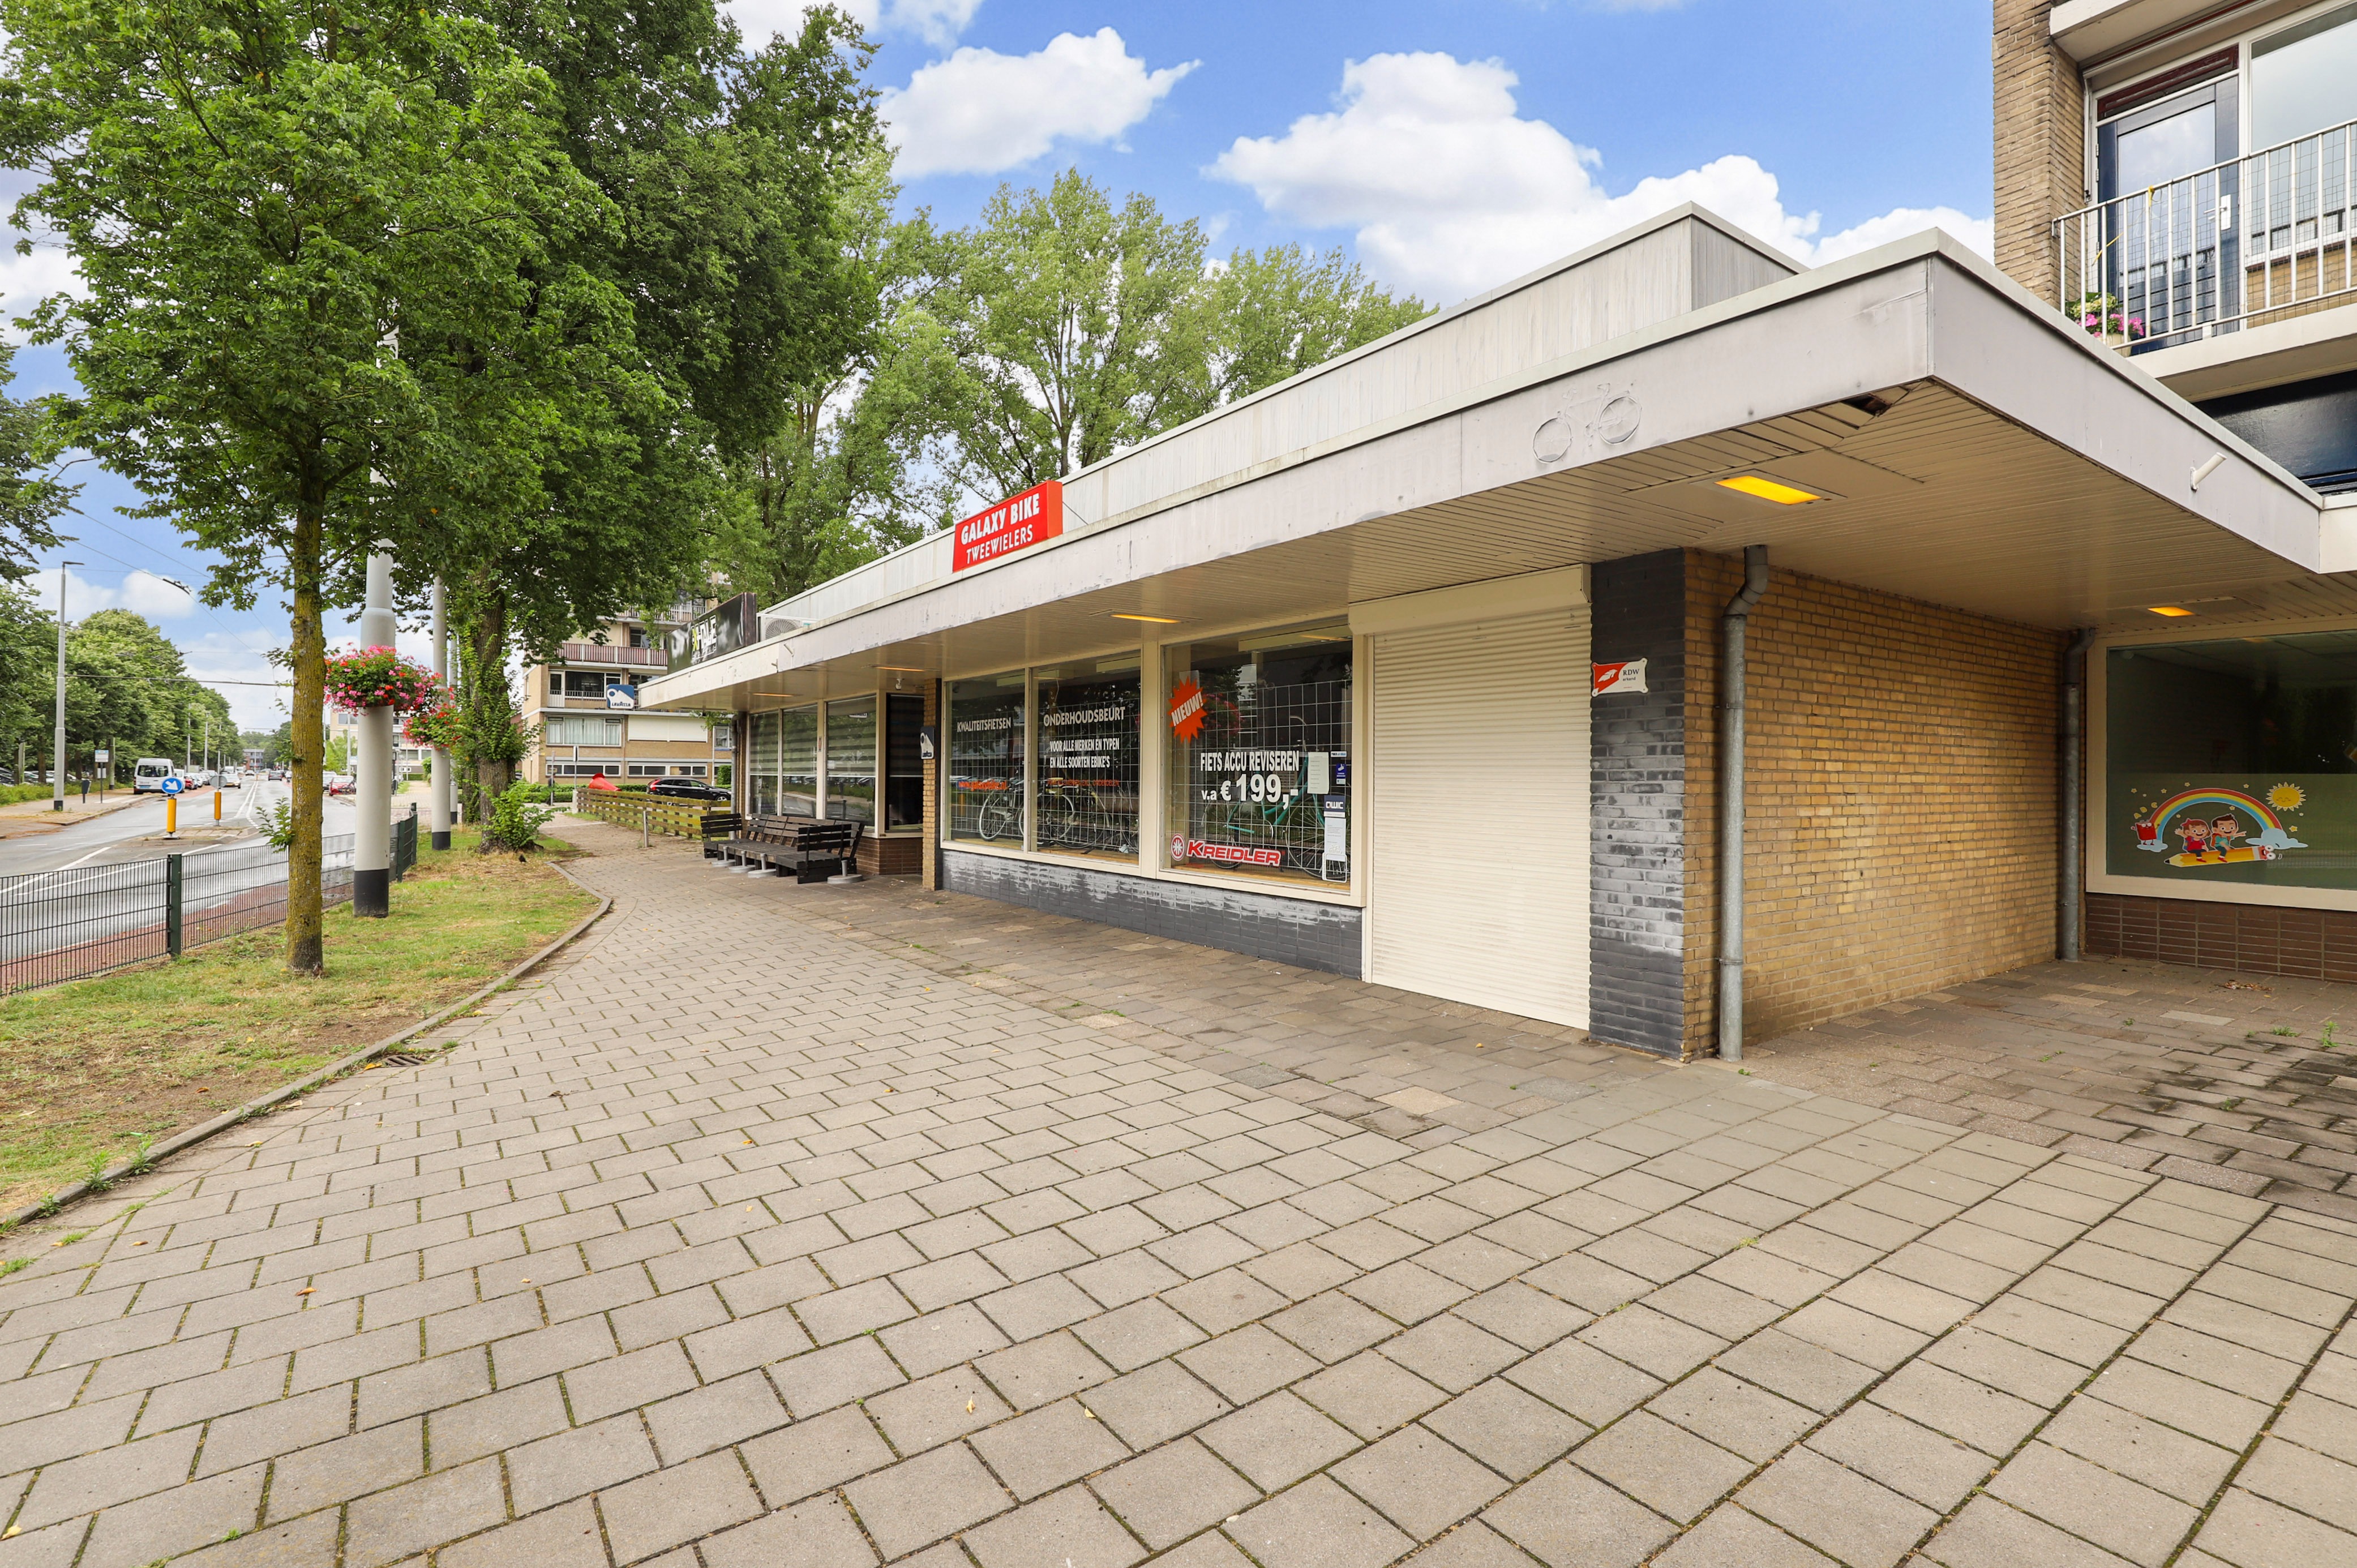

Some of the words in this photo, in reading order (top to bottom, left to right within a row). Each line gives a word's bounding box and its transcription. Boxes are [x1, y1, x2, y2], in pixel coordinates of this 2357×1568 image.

[961, 508, 1006, 545] GALAXY
[1010, 493, 1040, 525] BIKE
[966, 524, 1033, 564] TWEEWIELERS
[1044, 706, 1125, 726] ONDERHOUDSBEURT
[1171, 691, 1203, 726] NIEUW!
[957, 717, 1011, 732] KWALITEITSFIETSEN
[1050, 741, 1062, 752] VOOR
[1063, 740, 1074, 751] ALLE
[1075, 739, 1094, 751] MERKEN
[1095, 739, 1102, 750] EN
[1103, 738, 1119, 750] TYPEN
[1050, 757, 1056, 768] EN
[1057, 757, 1068, 768] ALLE
[1068, 756, 1090, 768] SOORTEN
[1091, 756, 1110, 768] EBIKE'S
[1201, 752, 1222, 771] FIETS
[1224, 752, 1246, 771] ACCU
[1249, 751, 1299, 771] REVISEREN
[1201, 790, 1216, 800] v.a
[1236, 774, 1299, 810] 199,-
[1188, 841, 1280, 866] KREIDLER
